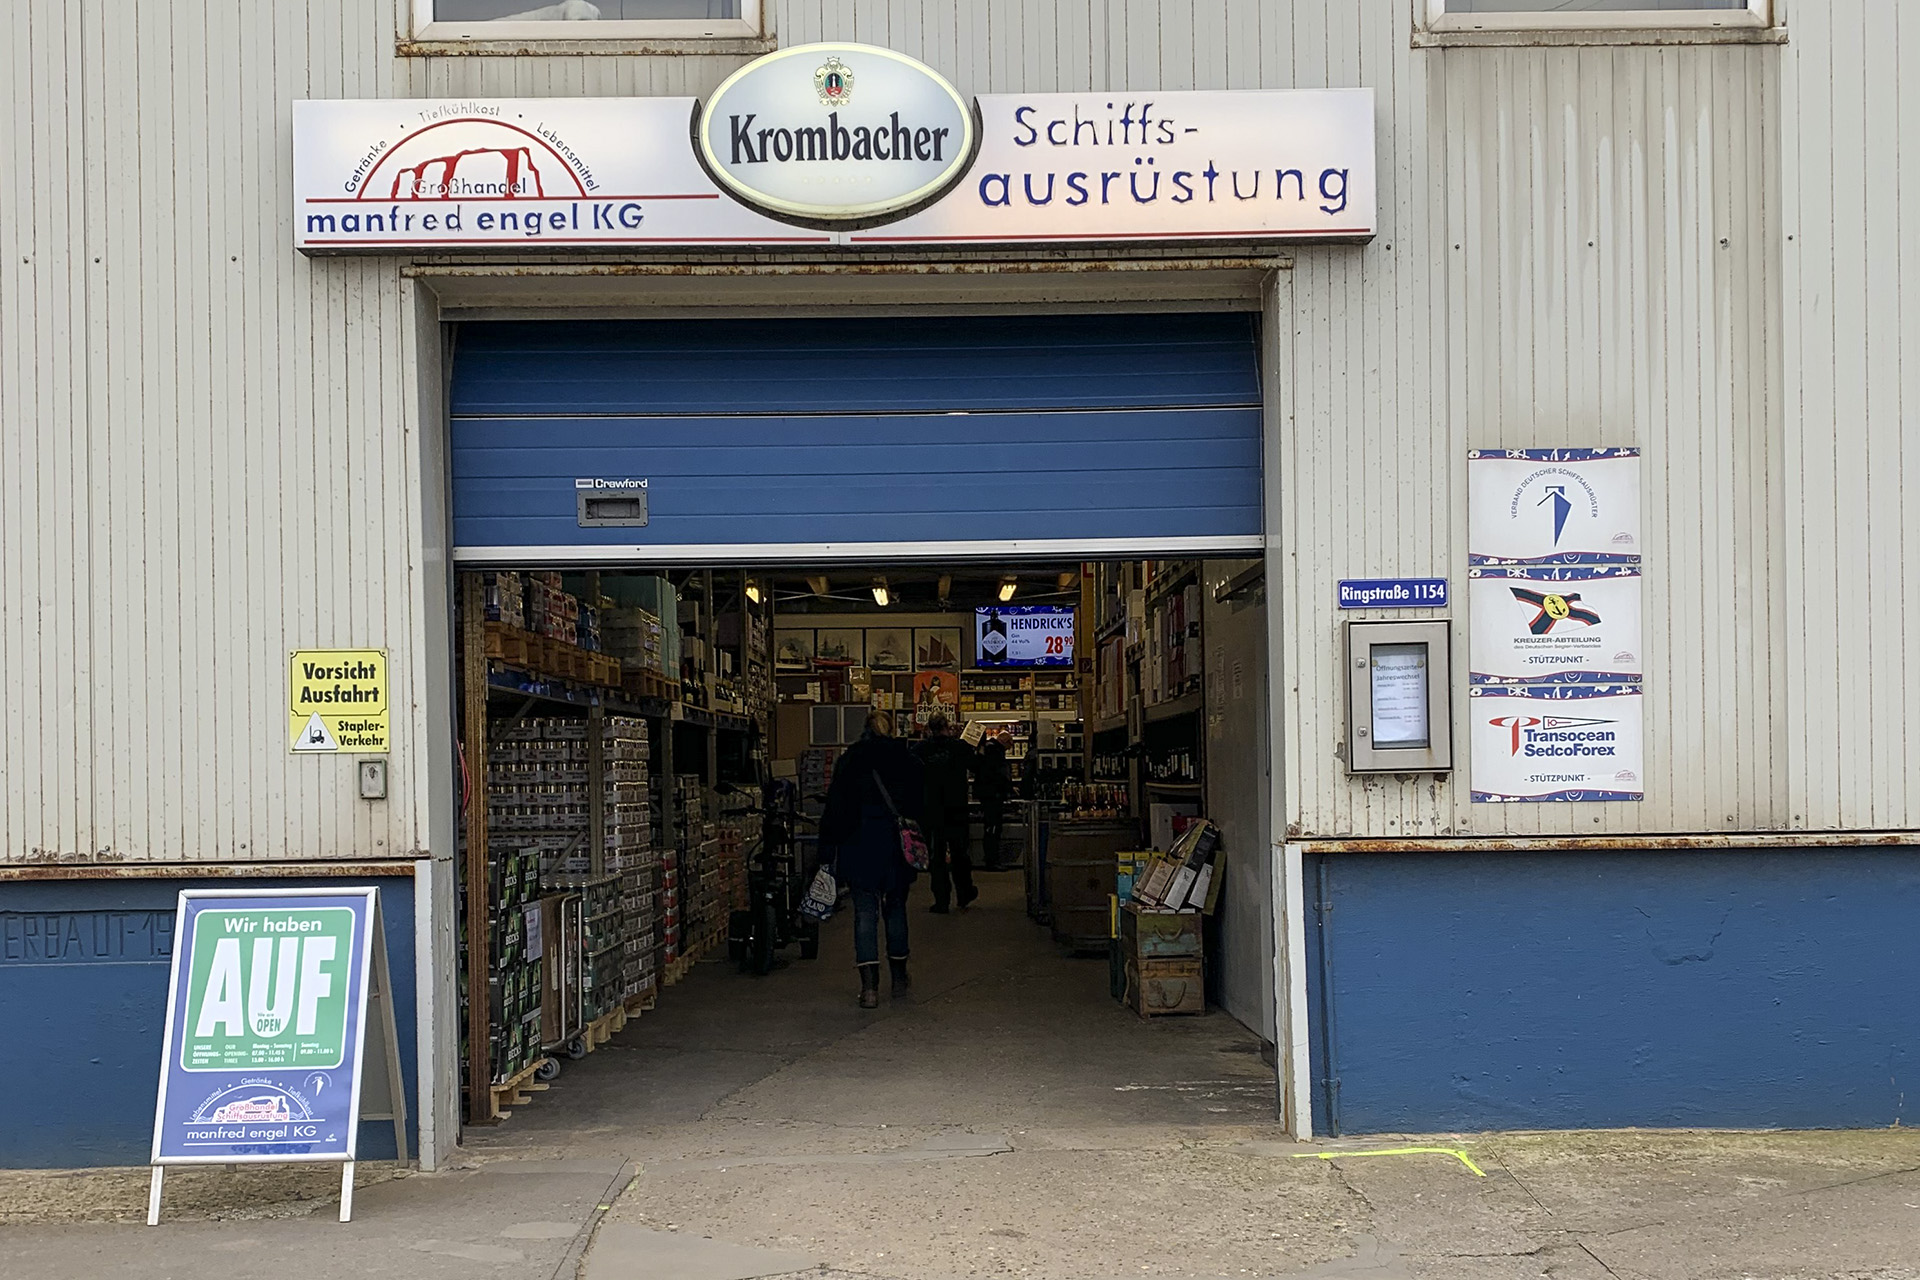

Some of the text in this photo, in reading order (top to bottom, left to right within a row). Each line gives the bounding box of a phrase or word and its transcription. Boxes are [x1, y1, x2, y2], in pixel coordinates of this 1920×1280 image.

[418, 102, 500, 122] Tiefkühlkost
[1013, 103, 1198, 147] Schiffs-
[729, 111, 948, 164] Krombacher
[536, 122, 600, 192] Lebensmittel
[344, 140, 387, 193] Getränke
[412, 177, 526, 195] Großhandel
[979, 158, 1350, 215] ausrüstung
[307, 202, 645, 236] manfred engel KG
[595, 478, 648, 488] Crawford
[1510, 467, 1598, 519] VERBAND DEUTSCHER SCHIFFSAUSRÜSTER
[1341, 584, 1445, 603] Ringstraße 1154
[1010, 617, 1073, 630] HENDRICK'S
[1045, 635, 1064, 654] 28
[1528, 655, 1584, 664] STÜTZPUNKT
[302, 661, 376, 680] Vorsicht
[300, 684, 379, 703] Ausfahrt
[338, 720, 384, 733] Stapler-
[1524, 729, 1616, 742] Transocean
[339, 734, 384, 746] Verkehr
[1524, 743, 1616, 757] SedcoForex
[1530, 773, 1585, 782] STÜTZPUNKT
[223, 916, 322, 933] Wir haben
[194, 936, 337, 1038] AUF
[256, 1018, 281, 1032] OPEN
[240, 1077, 272, 1086] Getränke
[189, 1088, 222, 1120] Lebensmittel
[229, 1103, 278, 1111] Großhandel
[287, 1086, 314, 1116] Tiefkühlkost
[217, 1112, 288, 1121] Schiffsausrüstung
[186, 1125, 317, 1141] manfred engel KG
